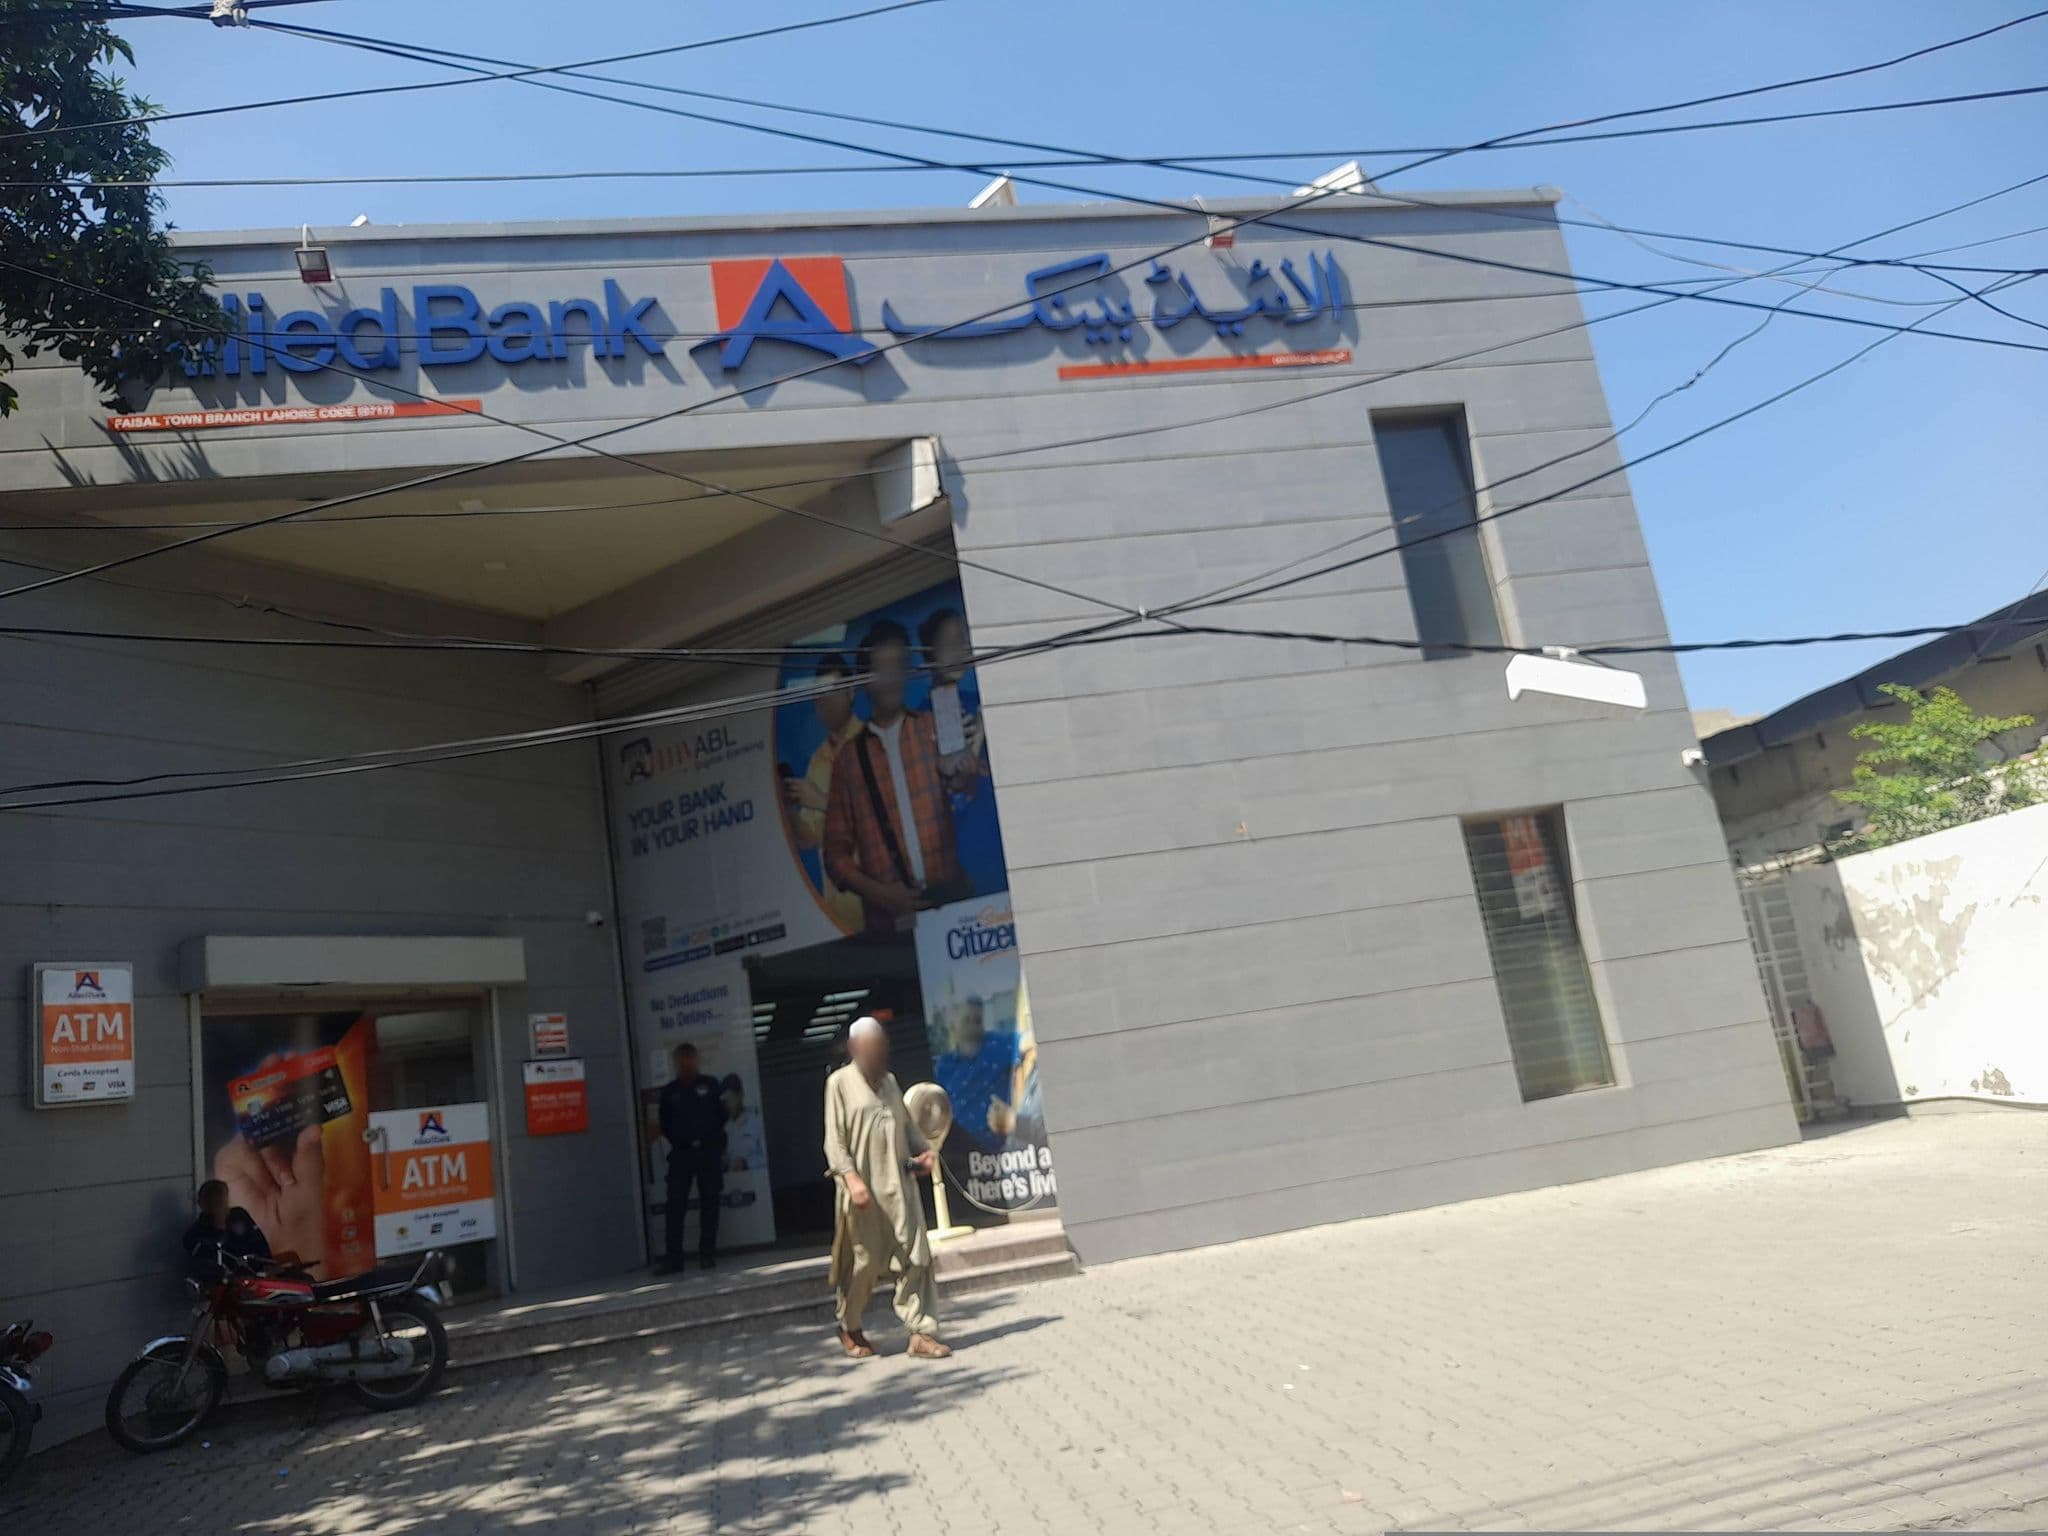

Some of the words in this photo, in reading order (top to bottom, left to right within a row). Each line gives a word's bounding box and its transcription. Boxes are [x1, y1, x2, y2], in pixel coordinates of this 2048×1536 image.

[414, 279, 665, 366] Bank
[114, 415, 160, 428] FAISAL
[163, 414, 202, 426] TOWN
[205, 411, 259, 424] BRANCH
[263, 407, 317, 421] LAHORE
[319, 405, 357, 419] CODE
[628, 800, 674, 831] YOUR
[679, 783, 727, 816] BANK
[631, 834, 648, 856] IN
[652, 818, 699, 849] YOUR
[703, 800, 754, 834] HAND
[52, 1012, 124, 1043] ATM
[401, 1151, 468, 1190] ATM
[968, 1144, 1037, 1178] Beyond
[967, 1173, 1029, 1200] there's
